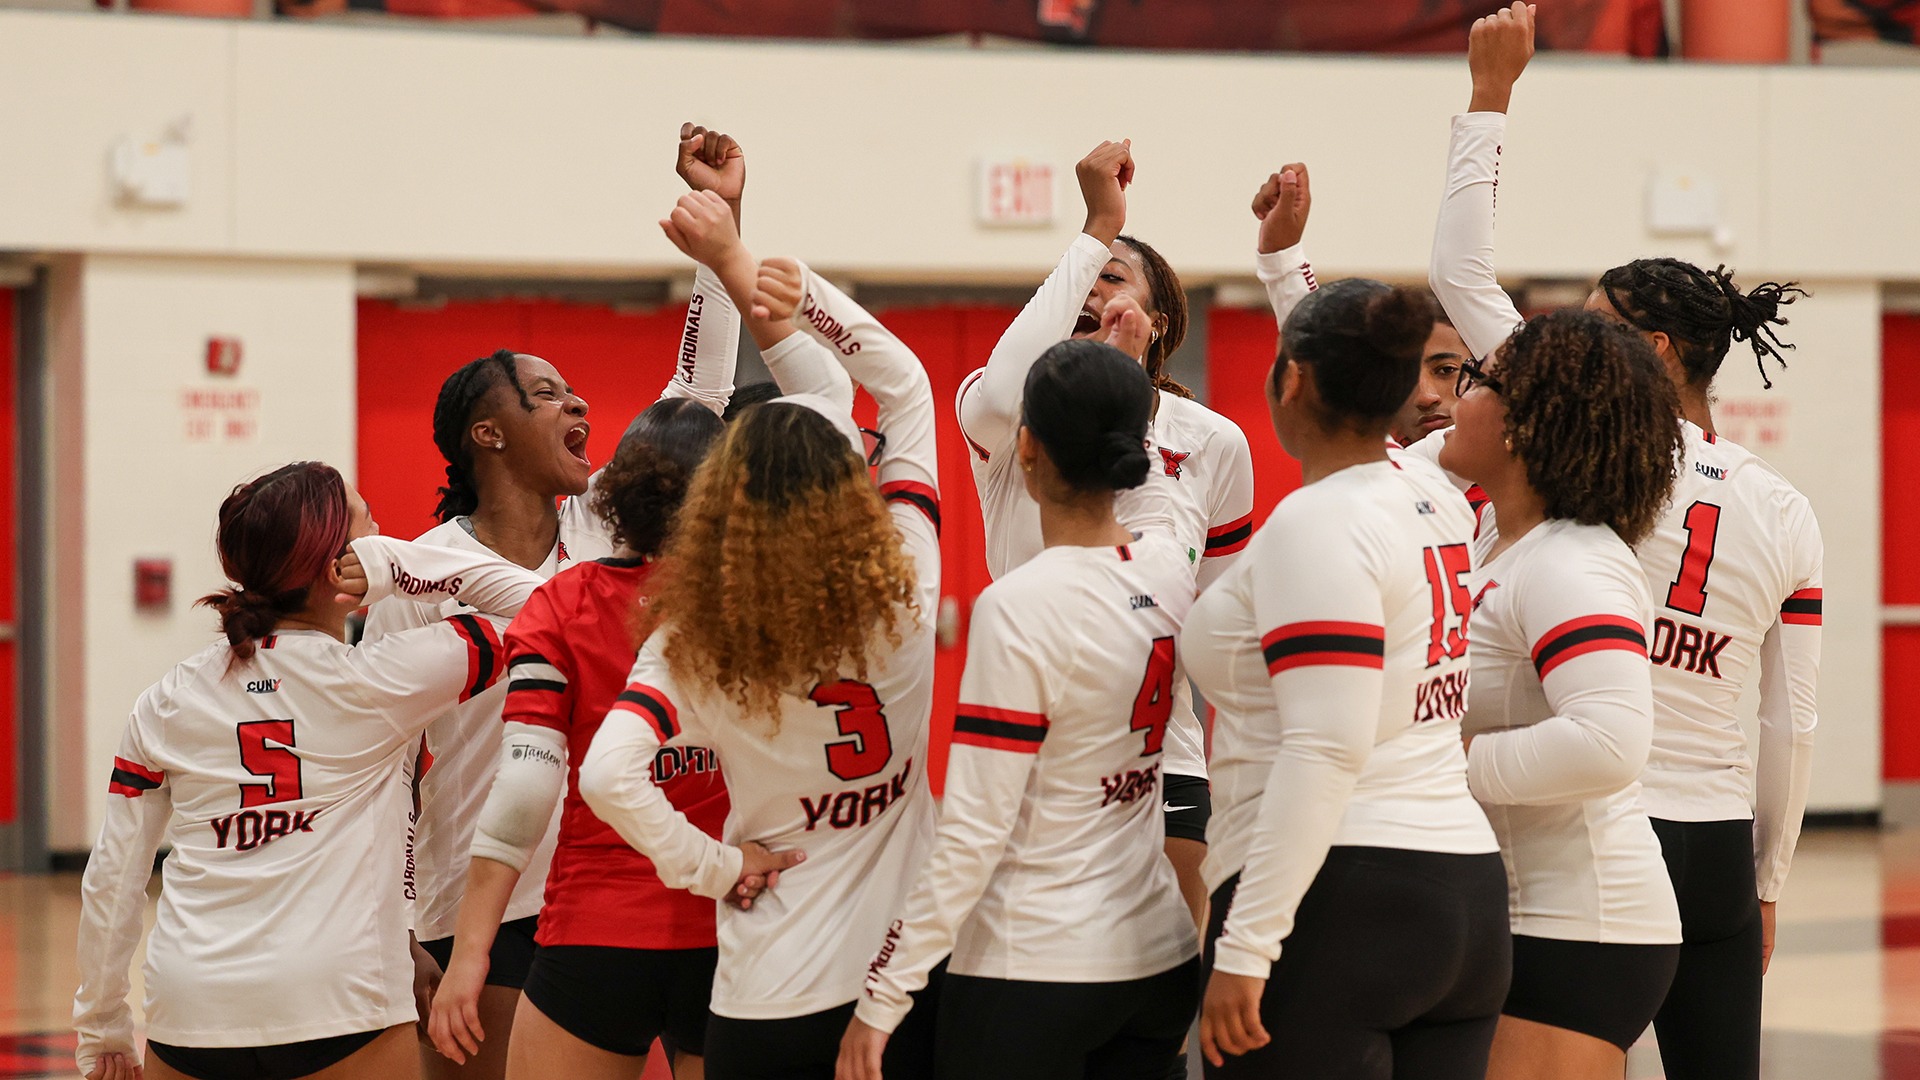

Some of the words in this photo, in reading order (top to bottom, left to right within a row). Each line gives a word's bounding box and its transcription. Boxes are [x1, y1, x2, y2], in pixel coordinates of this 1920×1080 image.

[681, 293, 704, 384] CARDINALS
[802, 293, 861, 356] CARDINLS
[1695, 461, 1728, 480] CUNY
[1665, 500, 1721, 617] 1
[1423, 543, 1471, 669] 15
[246, 678, 282, 694] CUNY
[1650, 616, 1733, 679] ORK
[808, 678, 893, 782] 3
[1130, 635, 1175, 757] 4
[236, 719, 303, 809] 5
[800, 756, 912, 831] YORK
[210, 809, 323, 851] YORK
